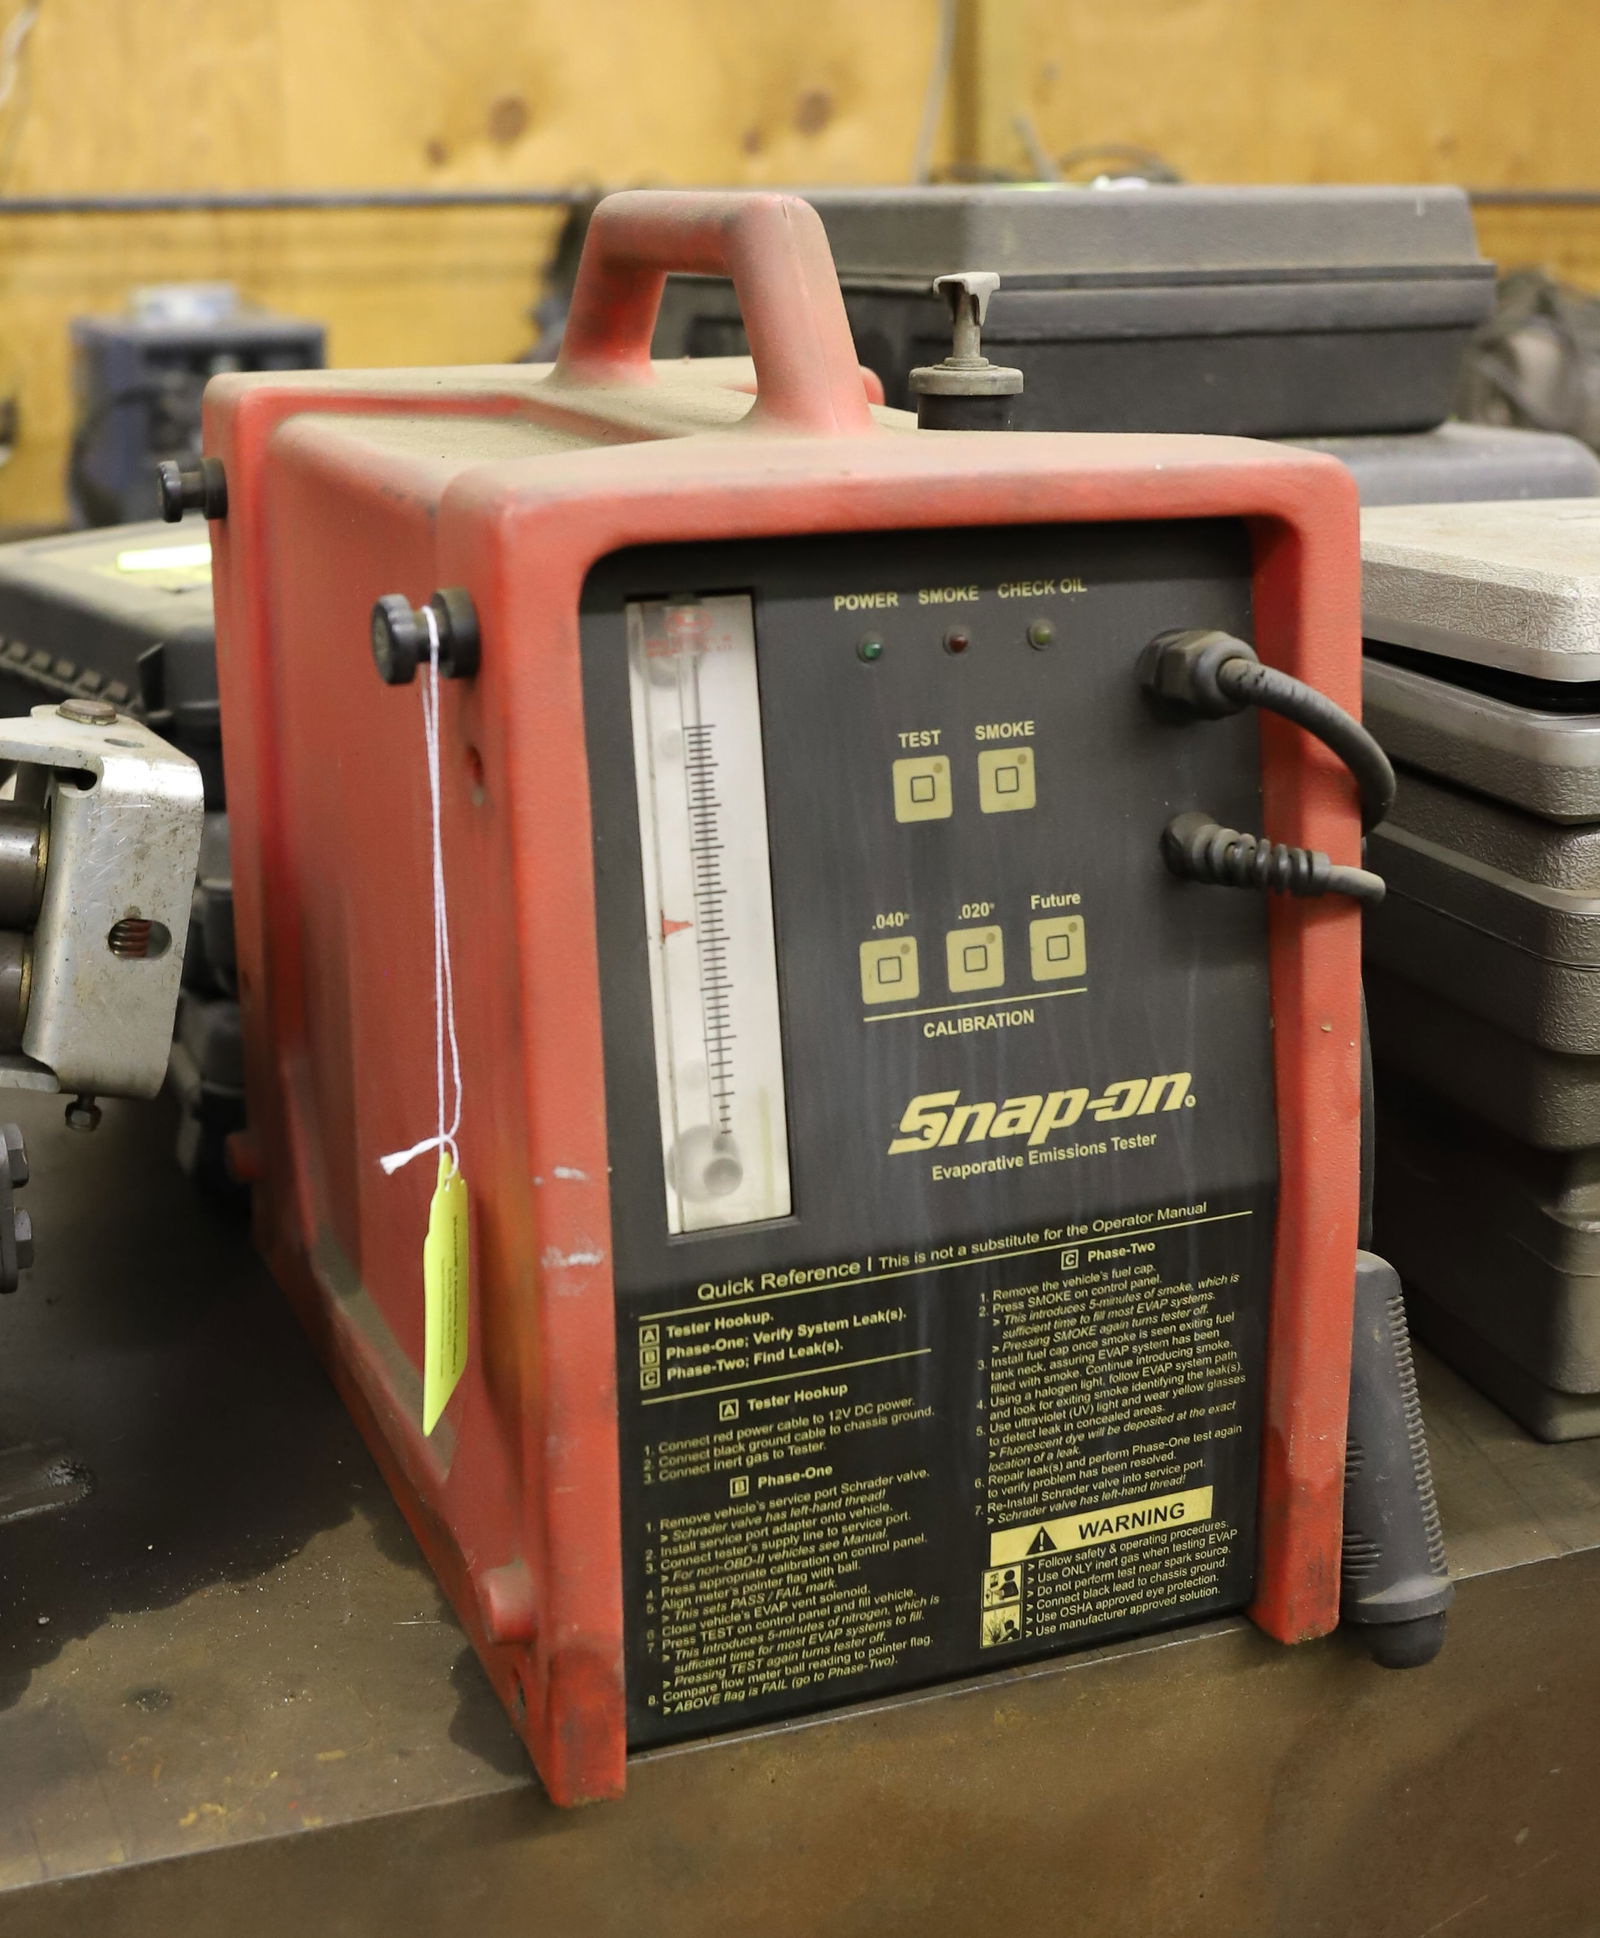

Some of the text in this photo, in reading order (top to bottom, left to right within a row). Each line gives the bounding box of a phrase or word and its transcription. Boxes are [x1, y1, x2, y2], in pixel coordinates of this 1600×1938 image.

[833, 592, 899, 612] POWER
[918, 587, 979, 606] SMOKE
[997, 577, 1087, 598] CHECK OIL
[899, 730, 941, 749] TEST
[974, 720, 1035, 742] SMOKE
[1031, 892, 1081, 910] Future
[923, 1009, 1035, 1039] CALIBRATION
[932, 1133, 1157, 1181] Evaporative Emissions Tester
[697, 1201, 1207, 1304] Quick Reference This is not a substitute for the Operator Manual
[1087, 1242, 1156, 1263] Phase-Two
[992, 1284, 1039, 1302] Remove
[1041, 1279, 1059, 1293] the
[1062, 1270, 1108, 1289] vehicle's
[1111, 1265, 1131, 1280] fuel
[1133, 1263, 1156, 1276] cap.
[992, 1300, 1024, 1315] Press
[1027, 1290, 1071, 1309] SMOKE
[1074, 1289, 1088, 1300] on
[1090, 1279, 1127, 1297] control
[1130, 1274, 1162, 1292] panel.
[666, 1322, 710, 1339] Tester
[714, 1313, 774, 1331] Hookup.
[753, 1328, 792, 1346] Verify
[797, 1320, 848, 1340] System
[853, 1308, 907, 1329] Leak(s).
[753, 1349, 784, 1367] Find
[788, 1340, 844, 1361] Leak(s).
[747, 1395, 789, 1412] Tester
[794, 1386, 848, 1404] Hookup
[658, 1434, 710, 1454] Connect
[712, 1429, 733, 1444] red
[736, 1424, 773, 1442] power
[776, 1417, 809, 1432] cable
[812, 1414, 824, 1426] to
[829, 1408, 850, 1423] 12V
[854, 1404, 873, 1418] DC
[876, 1398, 916, 1416] power.
[658, 1408, 935, 1468] Connect black ground cable to chassis ground.
[658, 1442, 827, 1482] Connect inert gas to Tester.
[988, 1470, 1023, 1486] Repair
[1026, 1461, 1063, 1478] leak(s)
[1065, 1456, 1085, 1471] and
[1088, 1450, 1130, 1468] perform
[1132, 1437, 1190, 1458] Phase-One
[1193, 1430, 1211, 1445] test
[1214, 1425, 1242, 1442] again
[757, 1466, 833, 1489] Phase-One
[987, 1492, 1038, 1513] Re-Install
[1041, 1483, 1089, 1502] Schrader
[1092, 1477, 1119, 1491] valve
[1122, 1471, 1141, 1485] into
[1144, 1464, 1180, 1480] service
[1183, 1457, 1206, 1474] port.
[659, 1511, 710, 1530] Remove
[714, 1499, 765, 1520] vehicle's
[769, 1492, 811, 1509] service
[814, 1485, 837, 1503] port
[840, 1476, 893, 1495] Schrader
[896, 1469, 930, 1485] valve.
[1079, 1502, 1185, 1540] WARNING
[1037, 1528, 1238, 1584] Use ONLY inert gas when testing EVAP
[1038, 1519, 1229, 1570] Follow safety & operating procedures.
[1036, 1558, 1228, 1611] Connect black lead to chassis ground.
[1037, 1545, 1231, 1597] Do not perform test near spark source.
[1035, 1586, 1220, 1637] Use manufacturer approved solution.
[1036, 1574, 1220, 1624] Use OSHA approved eye protection.
[662, 1682, 717, 1703] Compare
[720, 1676, 744, 1691] flow
[747, 1669, 781, 1685] meter
[784, 1661, 805, 1677] ball
[808, 1654, 850, 1672] reading
[854, 1649, 865, 1662] to
[868, 1642, 906, 1661] pointer
[910, 1636, 934, 1650] flag.
[673, 1693, 720, 1715] ABOVE
[722, 1690, 746, 1704] flag
[747, 1686, 759, 1698] is
[760, 1678, 788, 1695] FAIL
[790, 1675, 811, 1691] (go
[812, 1671, 825, 1684] to
